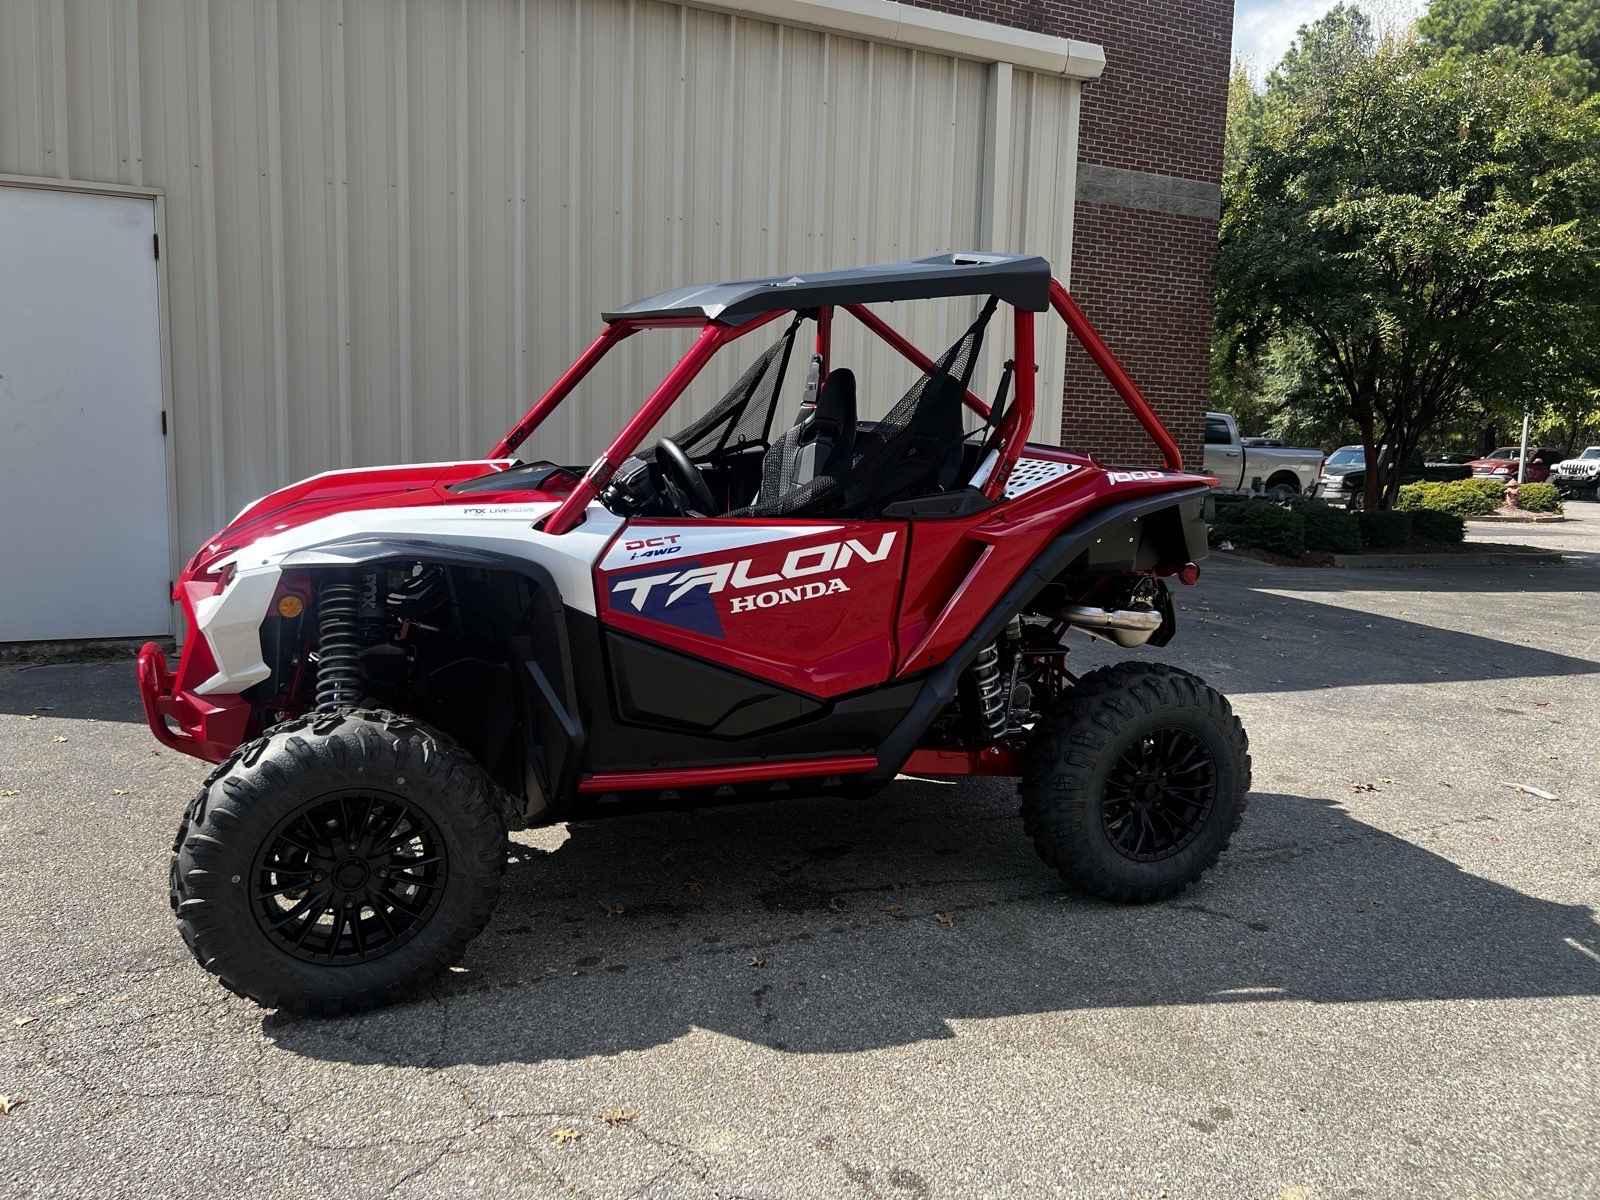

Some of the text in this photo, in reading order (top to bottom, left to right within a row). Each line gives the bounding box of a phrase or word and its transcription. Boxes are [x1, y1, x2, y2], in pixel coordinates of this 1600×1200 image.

[1106, 471, 1164, 486] 1000
[625, 534, 681, 551] DCT
[630, 546, 682, 561] i-4WD
[611, 531, 898, 612] TALON
[730, 577, 851, 614] HONDA
